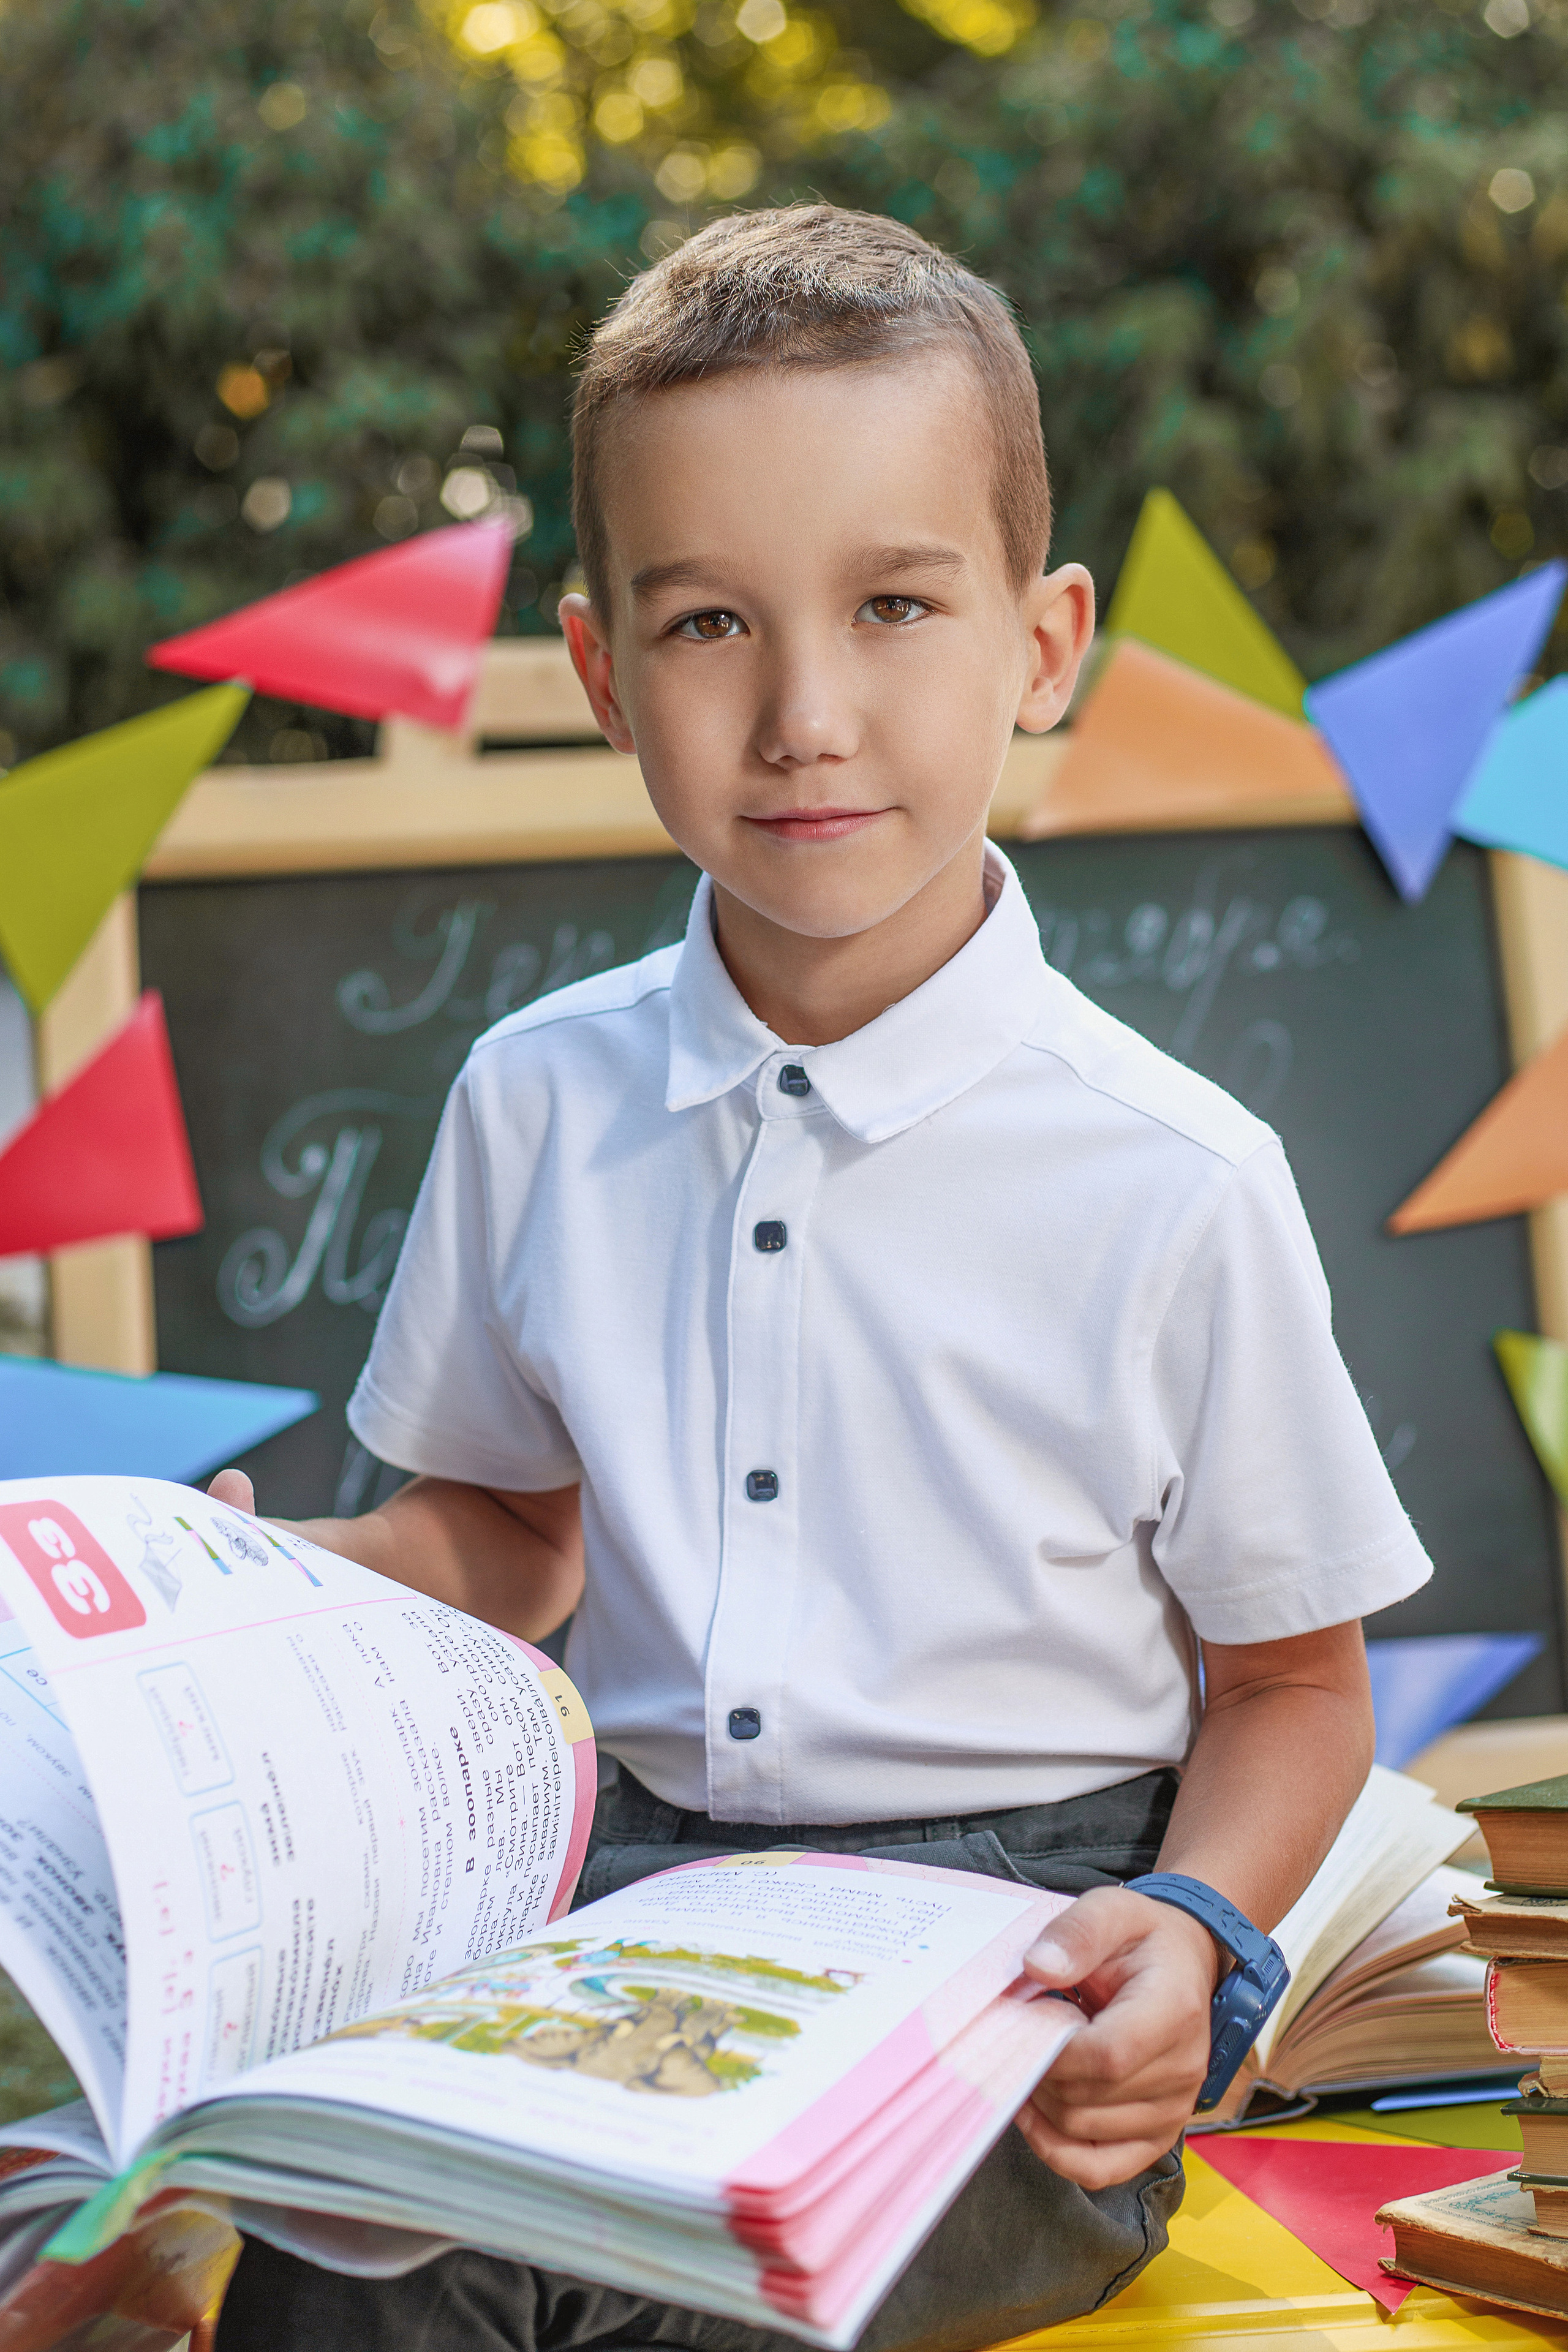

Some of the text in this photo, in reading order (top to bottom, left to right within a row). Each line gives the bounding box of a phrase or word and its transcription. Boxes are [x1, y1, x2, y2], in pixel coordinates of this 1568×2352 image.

[342, 1623, 372, 1663] пока
[353, 1621, 363, 1630] о
[286, 1635, 337, 1732] нарисованы
[371, 1645, 396, 1682] нам
[374, 1675, 385, 1689] А
[438, 1629, 500, 1722] смотрите!
[461, 1637, 494, 1683] слон.
[479, 1637, 526, 1695] усатые
[307, 1654, 347, 1731] Расскажи
[500, 1696, 513, 1725] он,
[554, 1693, 570, 1717] 91
[390, 1702, 422, 1792] зоопарк.
[509, 1696, 537, 1768] песком
[512, 1740, 527, 1777] Вот
[526, 1707, 543, 1746] Там
[339, 1751, 364, 1825] которые
[399, 1698, 441, 1822] рассказала
[402, 1612, 497, 1959] зоопарке разные звери. Вот за
[410, 1610, 507, 1959] бором лев. Мы сразу узнали
[432, 1741, 451, 1806] волке.
[363, 1797, 380, 1864] первый
[449, 1725, 477, 1873] В зоопарке
[521, 1781, 541, 1877] посыпает
[537, 1759, 551, 1860] аквариум.
[418, 1806, 429, 1897] посетим
[440, 1822, 454, 1909] степном
[514, 1812, 529, 1870] Зина.
[368, 1877, 380, 1941] Назови
[421, 1839, 442, 1944] Ивановна
[517, 1890, 524, 1901] и
[517, 1874, 538, 1939] опарке
[532, 1873, 548, 1909] Нас
[748, 1878, 815, 1888] скажет
[829, 1886, 881, 1898] мама
[895, 1896, 951, 1911] Пусть
[412, 1910, 424, 1941] мы
[435, 1923, 442, 1935] и
[485, 1912, 500, 1953] она.
[496, 1883, 518, 1950] икнула
[344, 1929, 368, 2022] Рассмотри
